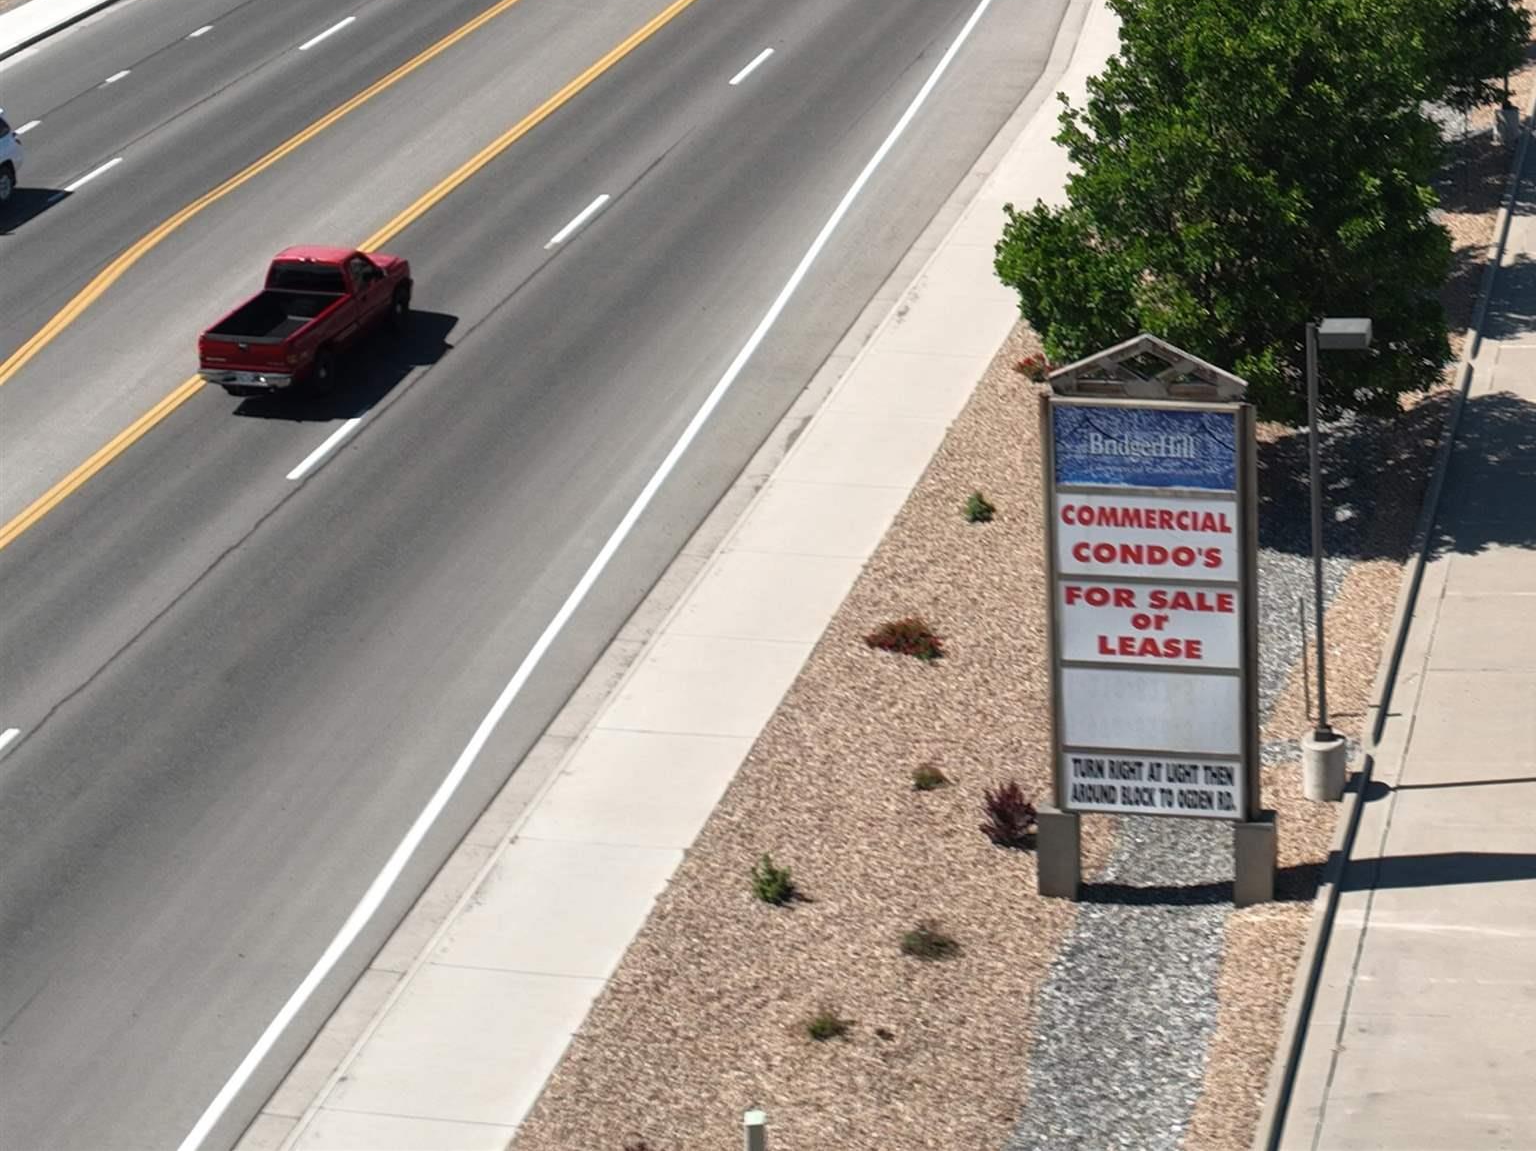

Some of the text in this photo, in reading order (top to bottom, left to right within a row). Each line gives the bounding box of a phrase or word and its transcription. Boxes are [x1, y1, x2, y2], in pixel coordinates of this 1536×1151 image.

[1060, 503, 1233, 534] COMMERCIAL
[1071, 540, 1223, 569] CONDO'S
[1064, 585, 1236, 614] FOR SALE
[1131, 613, 1170, 631] or
[1097, 635, 1203, 660] LEASE
[1072, 757, 1235, 787] TURN RIGHT AT LIGHT THEN
[1071, 783, 1118, 805] AROUND
[1120, 785, 1157, 808] BLOCK
[1159, 787, 1174, 808] TO
[1177, 789, 1214, 810] OGDEN
